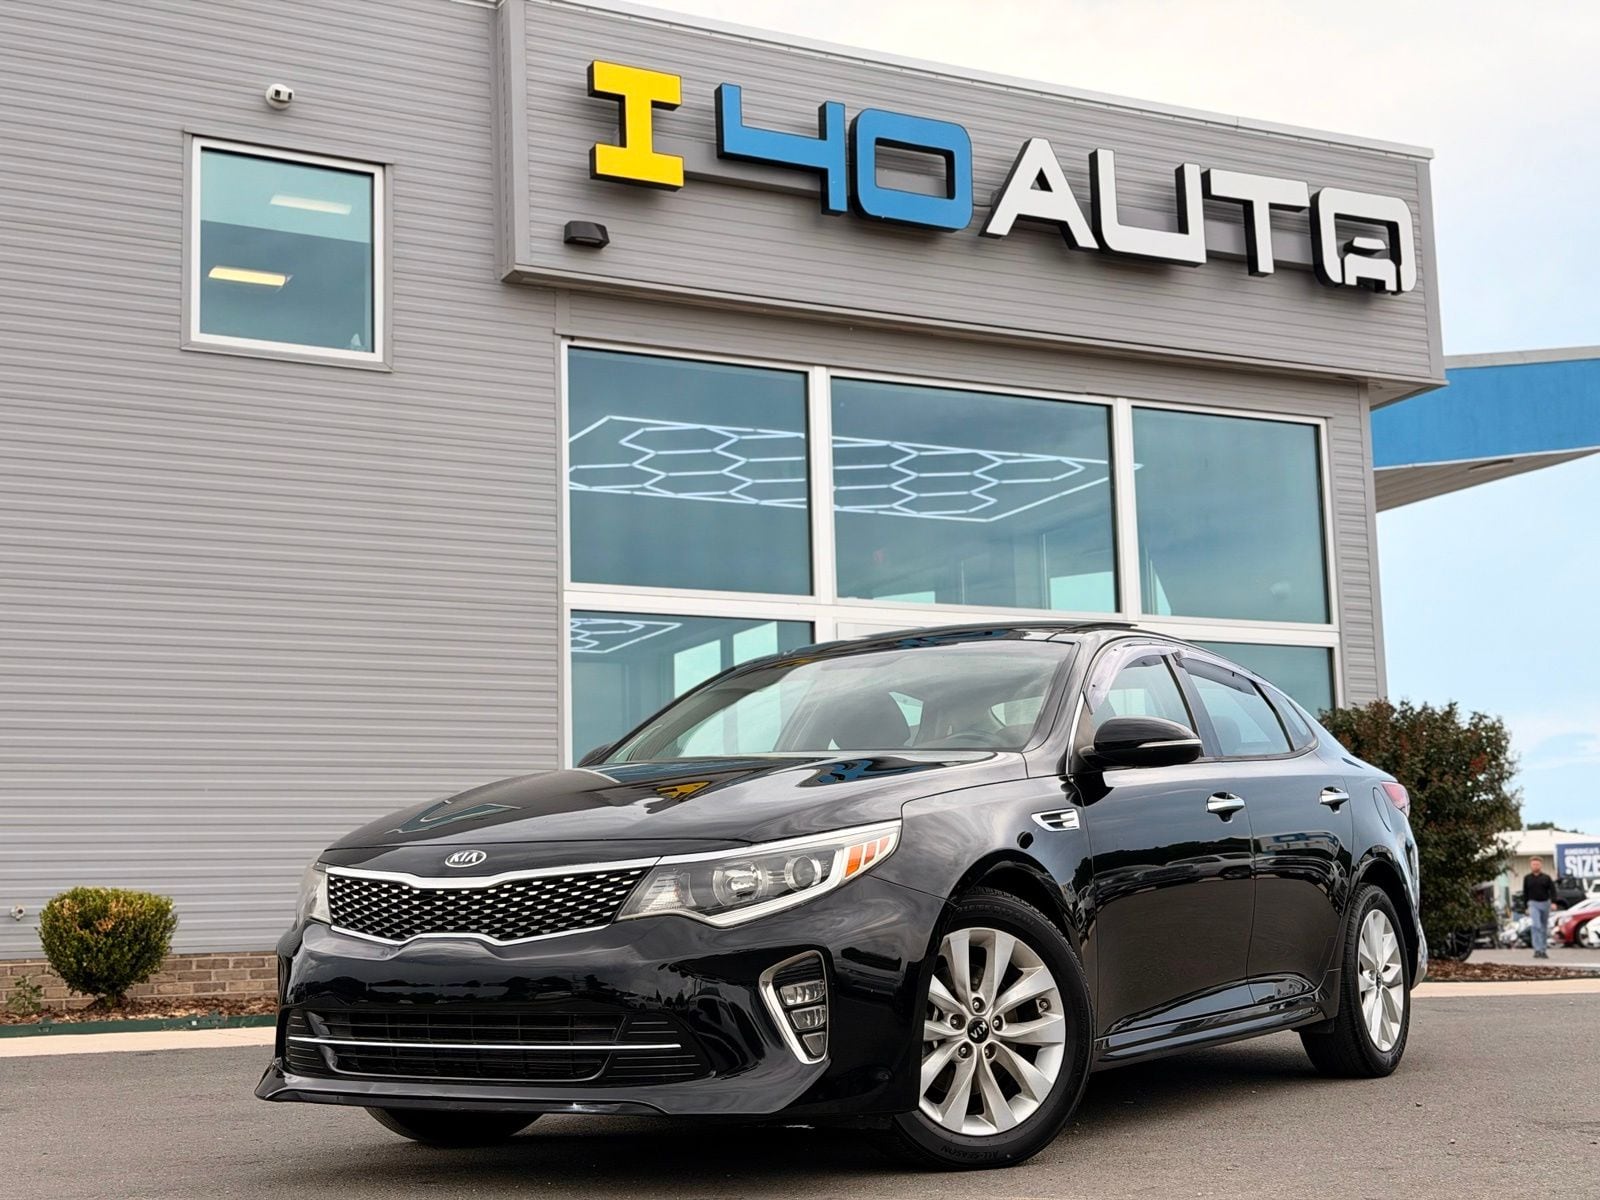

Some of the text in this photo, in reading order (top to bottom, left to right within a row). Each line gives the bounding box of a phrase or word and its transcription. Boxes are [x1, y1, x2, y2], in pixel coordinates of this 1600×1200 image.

[587, 60, 1419, 296] I 40 AUTO
[448, 851, 481, 865] KIA
[969, 1021, 988, 1039] KIA
